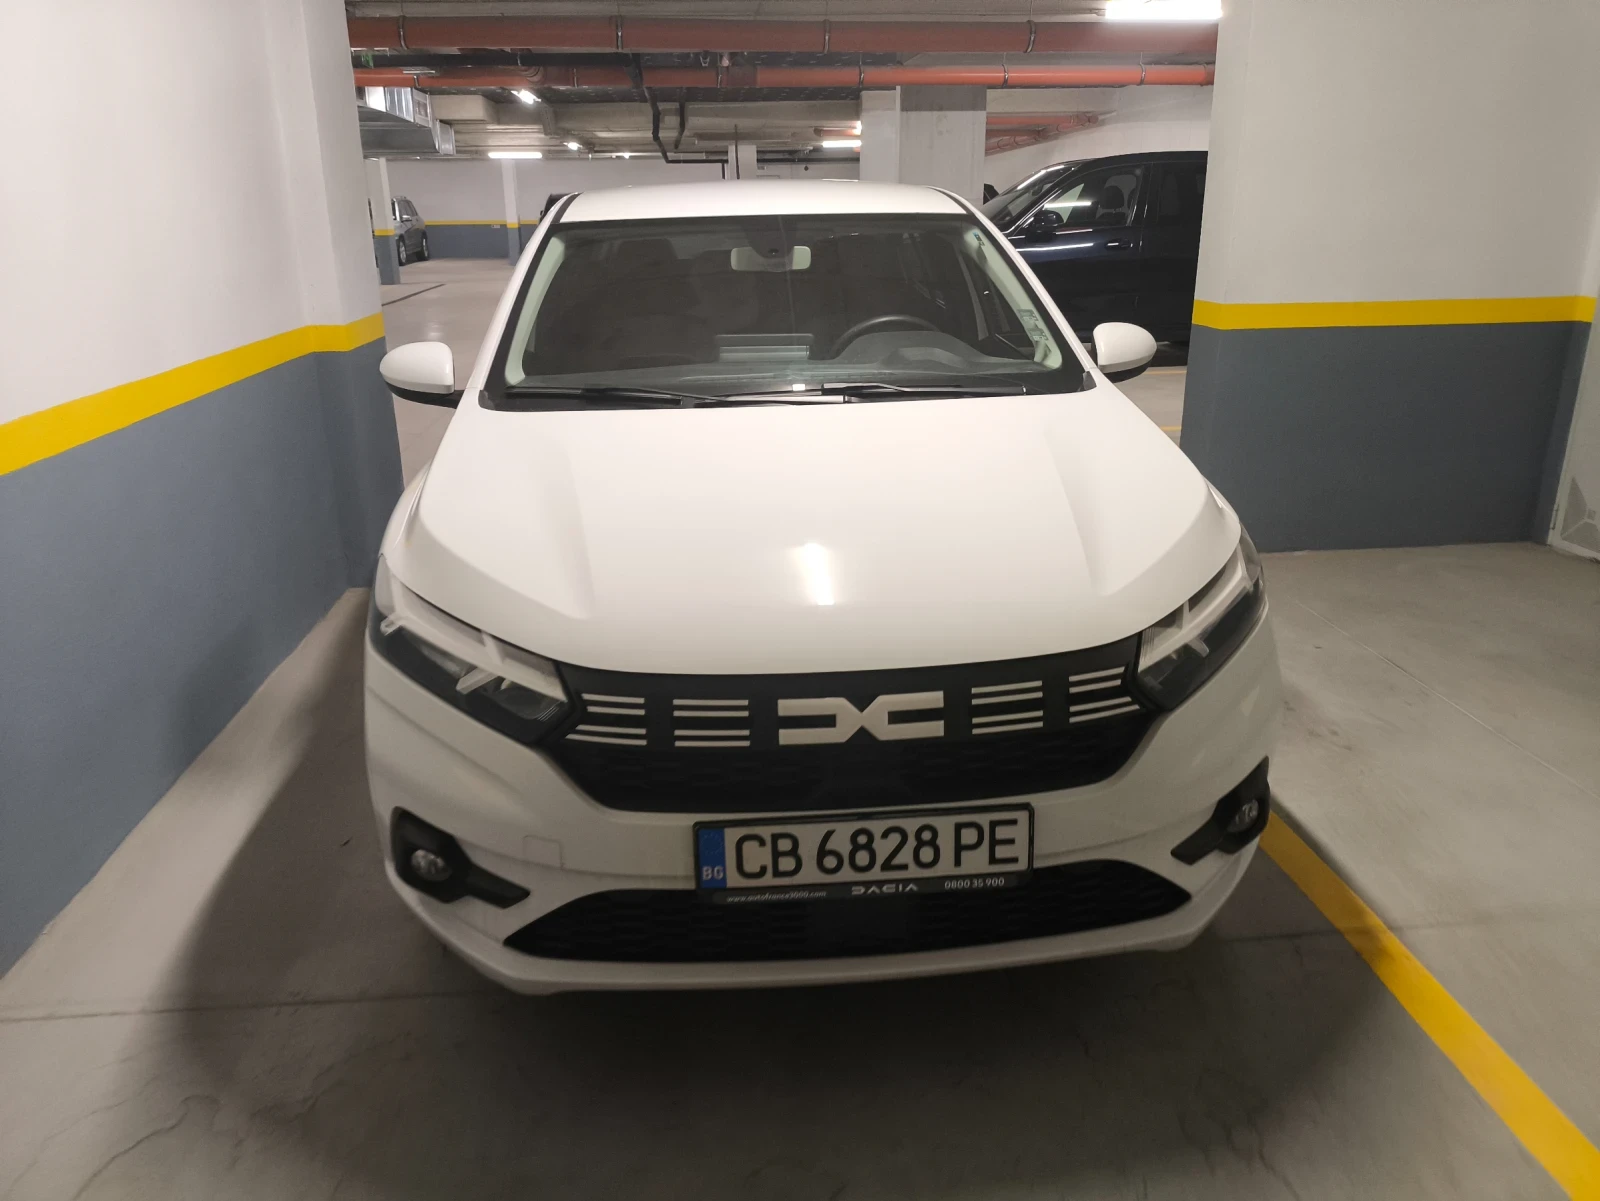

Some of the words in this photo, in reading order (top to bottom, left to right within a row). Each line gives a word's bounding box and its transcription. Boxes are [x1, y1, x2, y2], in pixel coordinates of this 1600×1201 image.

[734, 832, 803, 880] CB
[815, 823, 941, 876] 6828
[953, 818, 1020, 868] PE
[702, 865, 724, 880] BG
[851, 883, 919, 896] DACIA
[944, 879, 971, 890] 0800
[972, 878, 984, 888] 35
[985, 876, 1005, 888] 900
